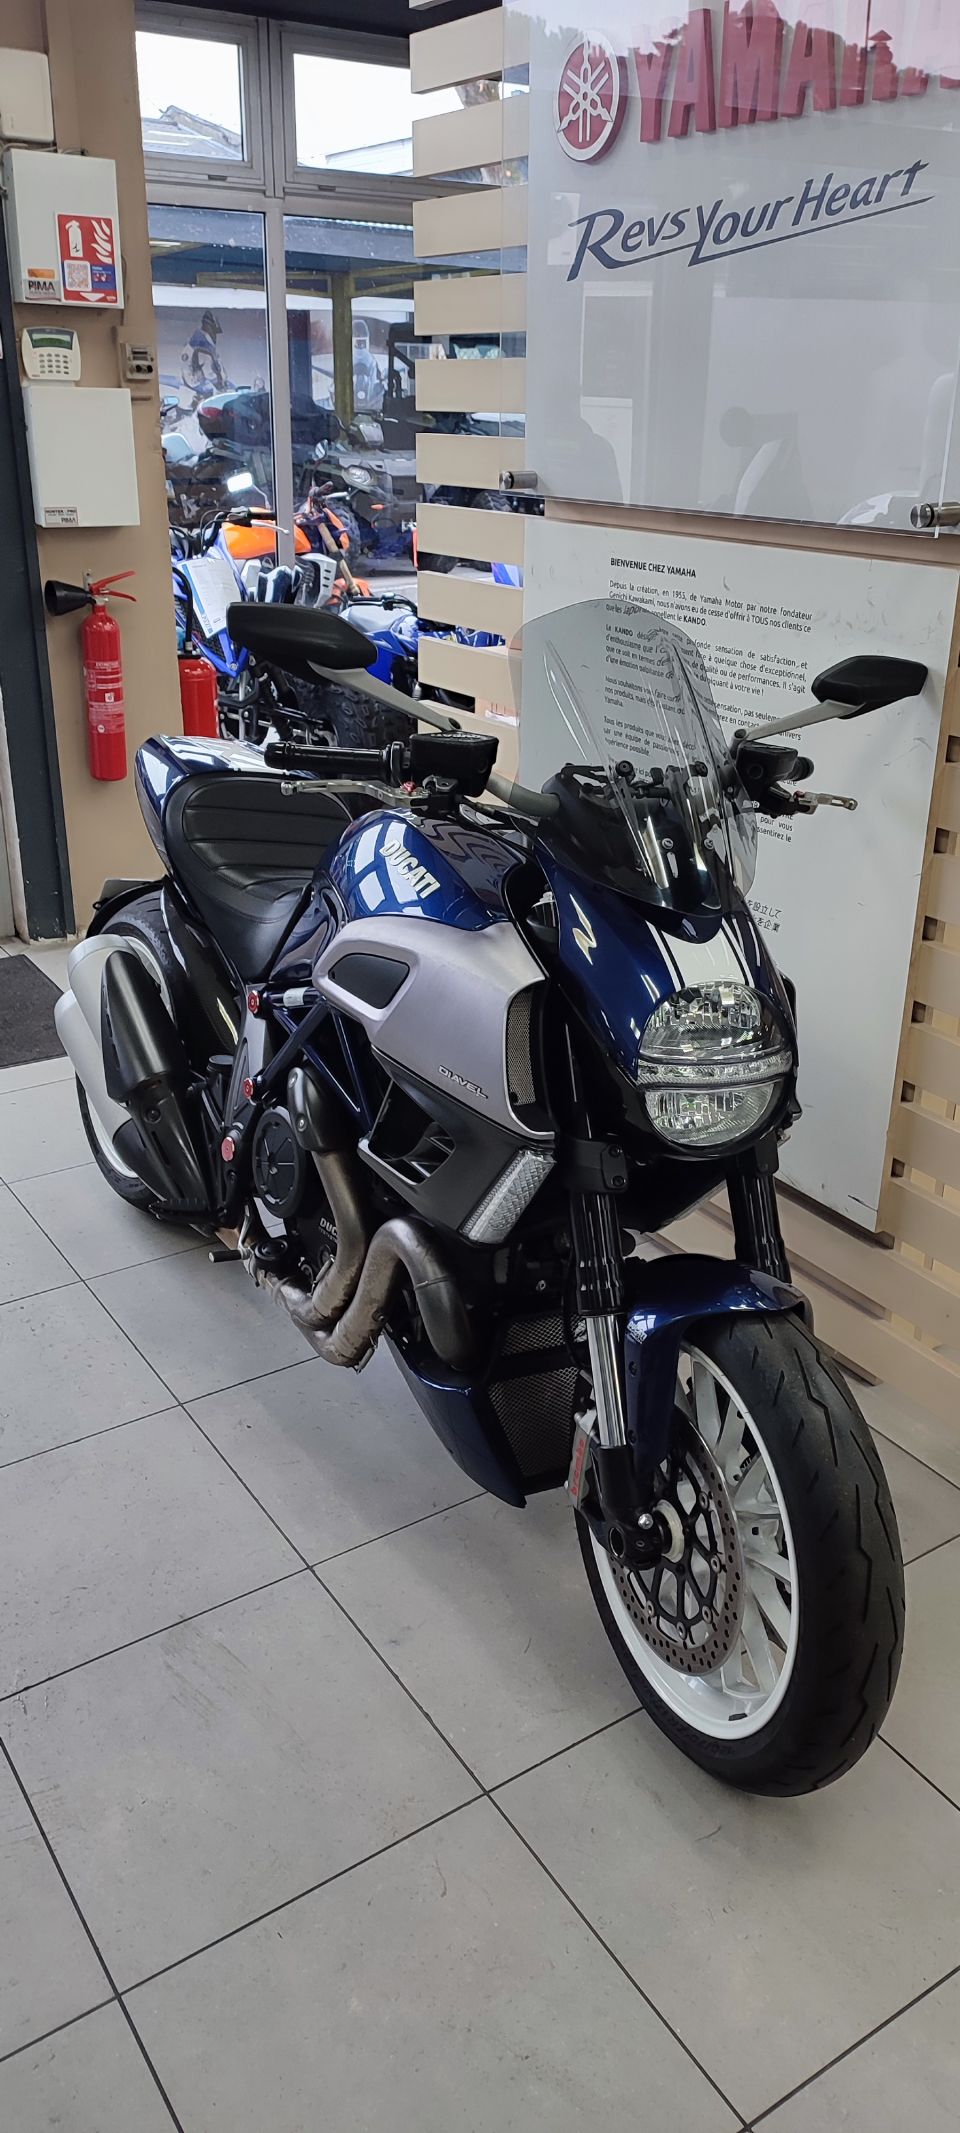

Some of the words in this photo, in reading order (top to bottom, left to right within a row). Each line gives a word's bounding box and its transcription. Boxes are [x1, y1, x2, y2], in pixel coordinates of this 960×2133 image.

[566, 208, 692, 282] Revs
[688, 198, 795, 268] Your
[791, 159, 930, 227] Heart
[28, 280, 55, 292] PIMA
[610, 557, 647, 571] BIENVENUE
[648, 562, 665, 574] CHEZ
[666, 565, 697, 578] YAMAHA
[609, 579, 627, 590] Depuis
[636, 585, 660, 597] création,
[672, 590, 687, 601] 1955,
[689, 593, 697, 602] de
[700, 594, 723, 606] Yamaha
[725, 598, 744, 610] Motor
[746, 603, 757, 612] par
[759, 606, 777, 615] notre
[780, 606, 813, 621] fondateur
[656, 600, 670, 609] nous
[670, 601, 691, 612] n'avons
[707, 609, 724, 618] cesse
[724, 611, 746, 621] d'offrir
[751, 615, 769, 626] TOUS
[769, 620, 781, 628] nos
[781, 620, 803, 632] clients
[683, 615, 708, 627] KANDO.
[715, 645, 744, 657] sensation
[747, 650, 756, 659] de
[713, 656, 738, 668] quelque
[739, 661, 757, 672] chose
[728, 670, 737, 679] de
[788, 682, 806, 695] s'agit
[734, 683, 751, 694] votre
[751, 687, 761, 696] vie
[743, 709, 755, 718] pas
[760, 816, 775, 826] pour
[778, 822, 793, 832] vous
[379, 839, 441, 899] DUCATI
[438, 1064, 489, 1100] DIAVEL
